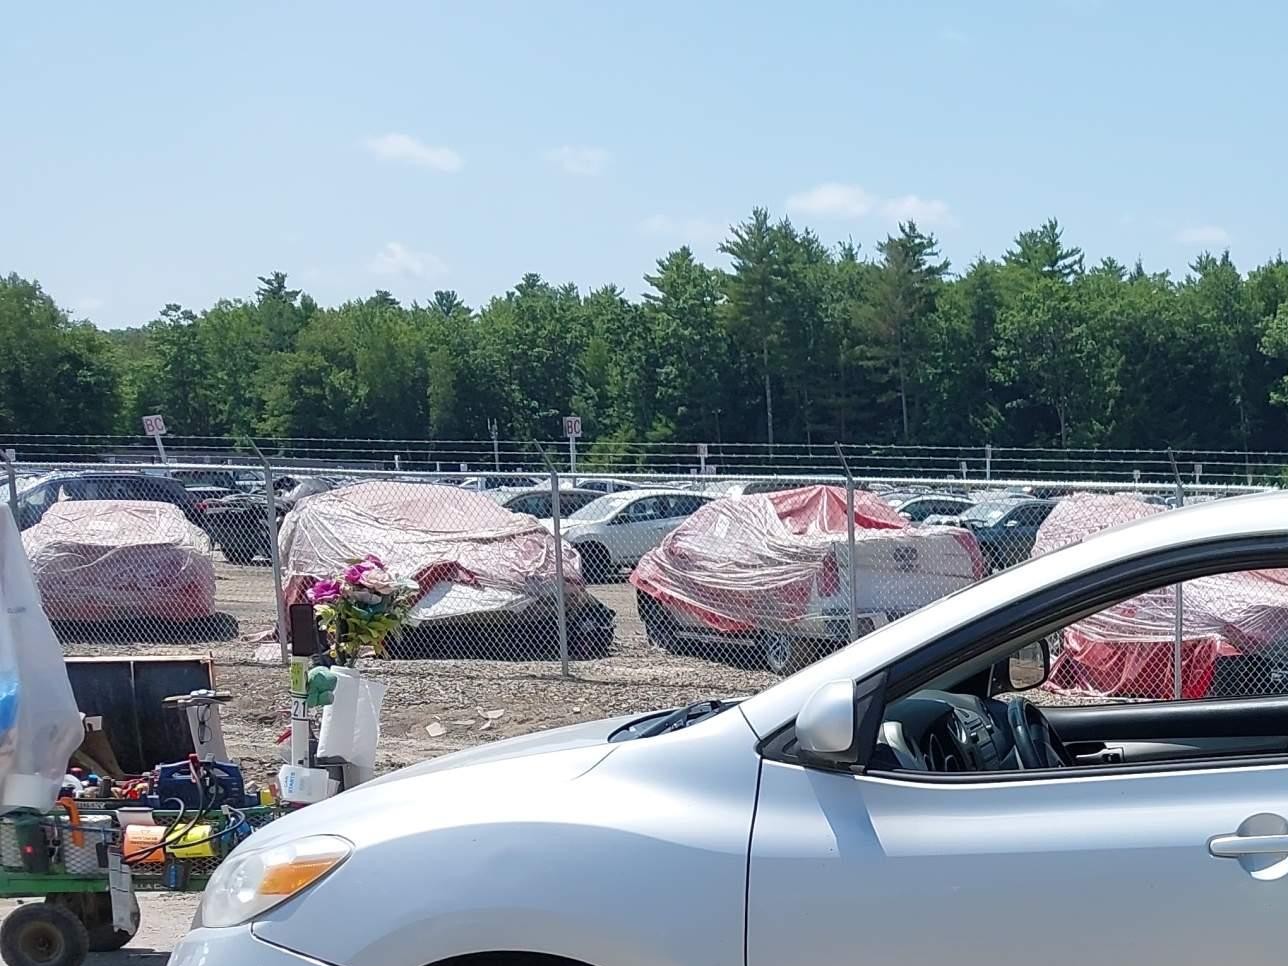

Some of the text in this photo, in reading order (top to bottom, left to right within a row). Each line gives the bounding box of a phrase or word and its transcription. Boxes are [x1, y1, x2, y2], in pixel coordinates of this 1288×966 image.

[145, 417, 164, 432] BC
[567, 420, 580, 434] BC
[294, 700, 306, 717] 21
